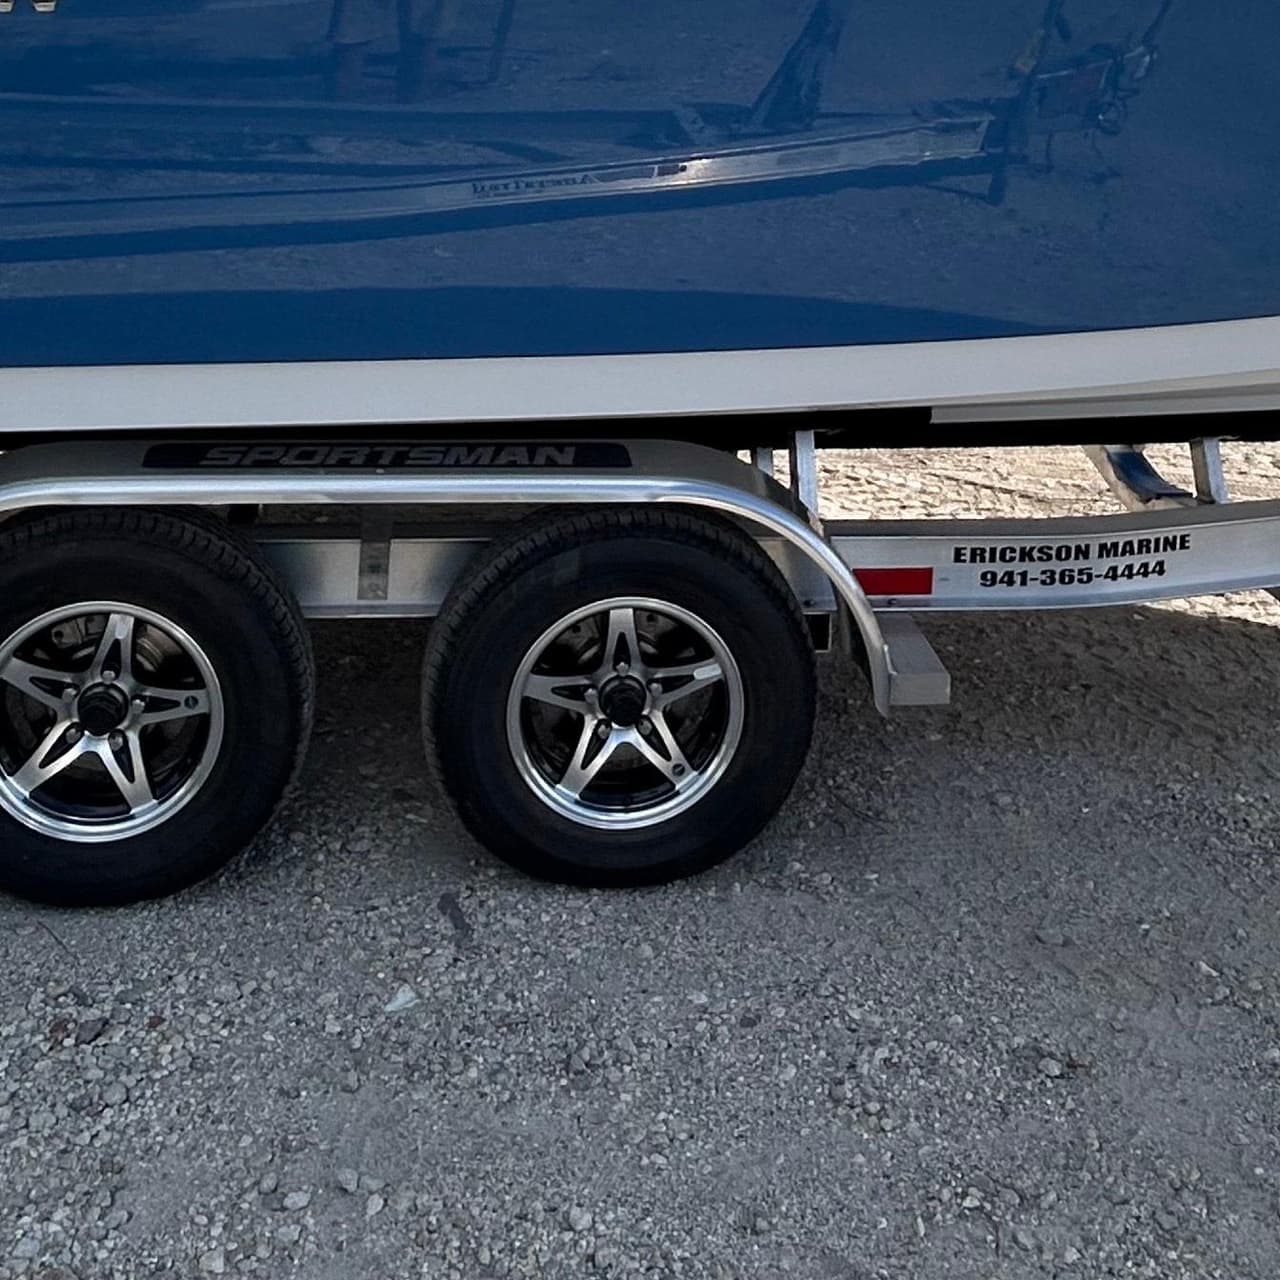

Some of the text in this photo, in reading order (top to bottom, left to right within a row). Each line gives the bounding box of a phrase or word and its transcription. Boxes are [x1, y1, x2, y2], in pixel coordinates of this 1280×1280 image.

[199, 445, 577, 466] SPORTSMAN
[952, 533, 1191, 564] ERICKSON MARINE
[979, 559, 1167, 588] 941-365-4444
